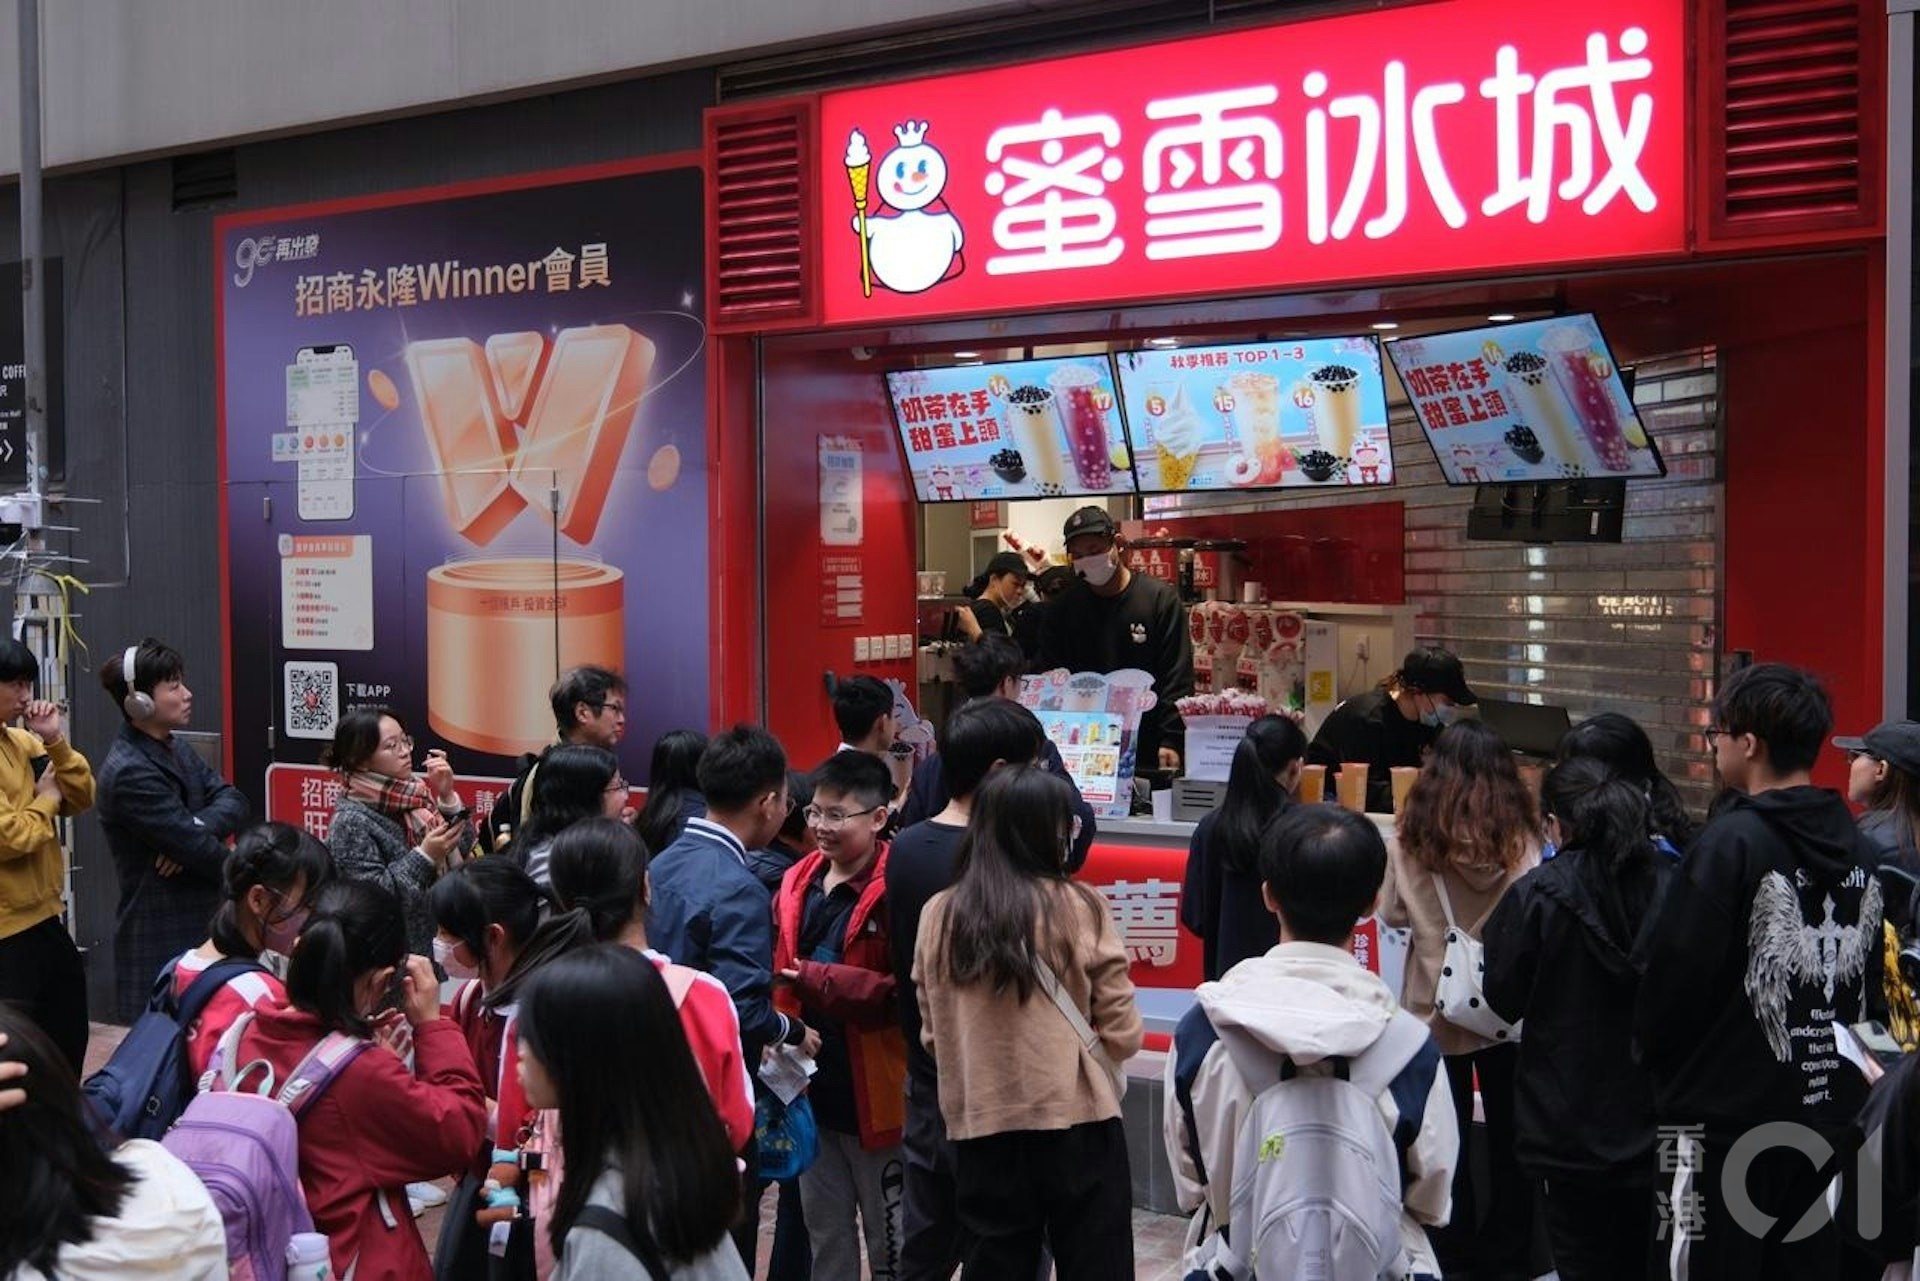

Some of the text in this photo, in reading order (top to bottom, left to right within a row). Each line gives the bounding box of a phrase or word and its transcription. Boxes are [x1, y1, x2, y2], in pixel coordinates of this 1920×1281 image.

[984, 26, 1658, 275] 蜜雪冰城
[296, 243, 612, 317] 招商永隆Winner會員
[1170, 350, 1230, 369] 秋季推荐
[1404, 357, 1491, 398] 奶茶在手
[900, 388, 992, 424] 奶茶在手
[1215, 395, 1234, 411] 15
[1295, 391, 1313, 408] 16
[1420, 389, 1509, 430] 甜蜜上頭
[908, 417, 1001, 453] 甜蜜上頭
